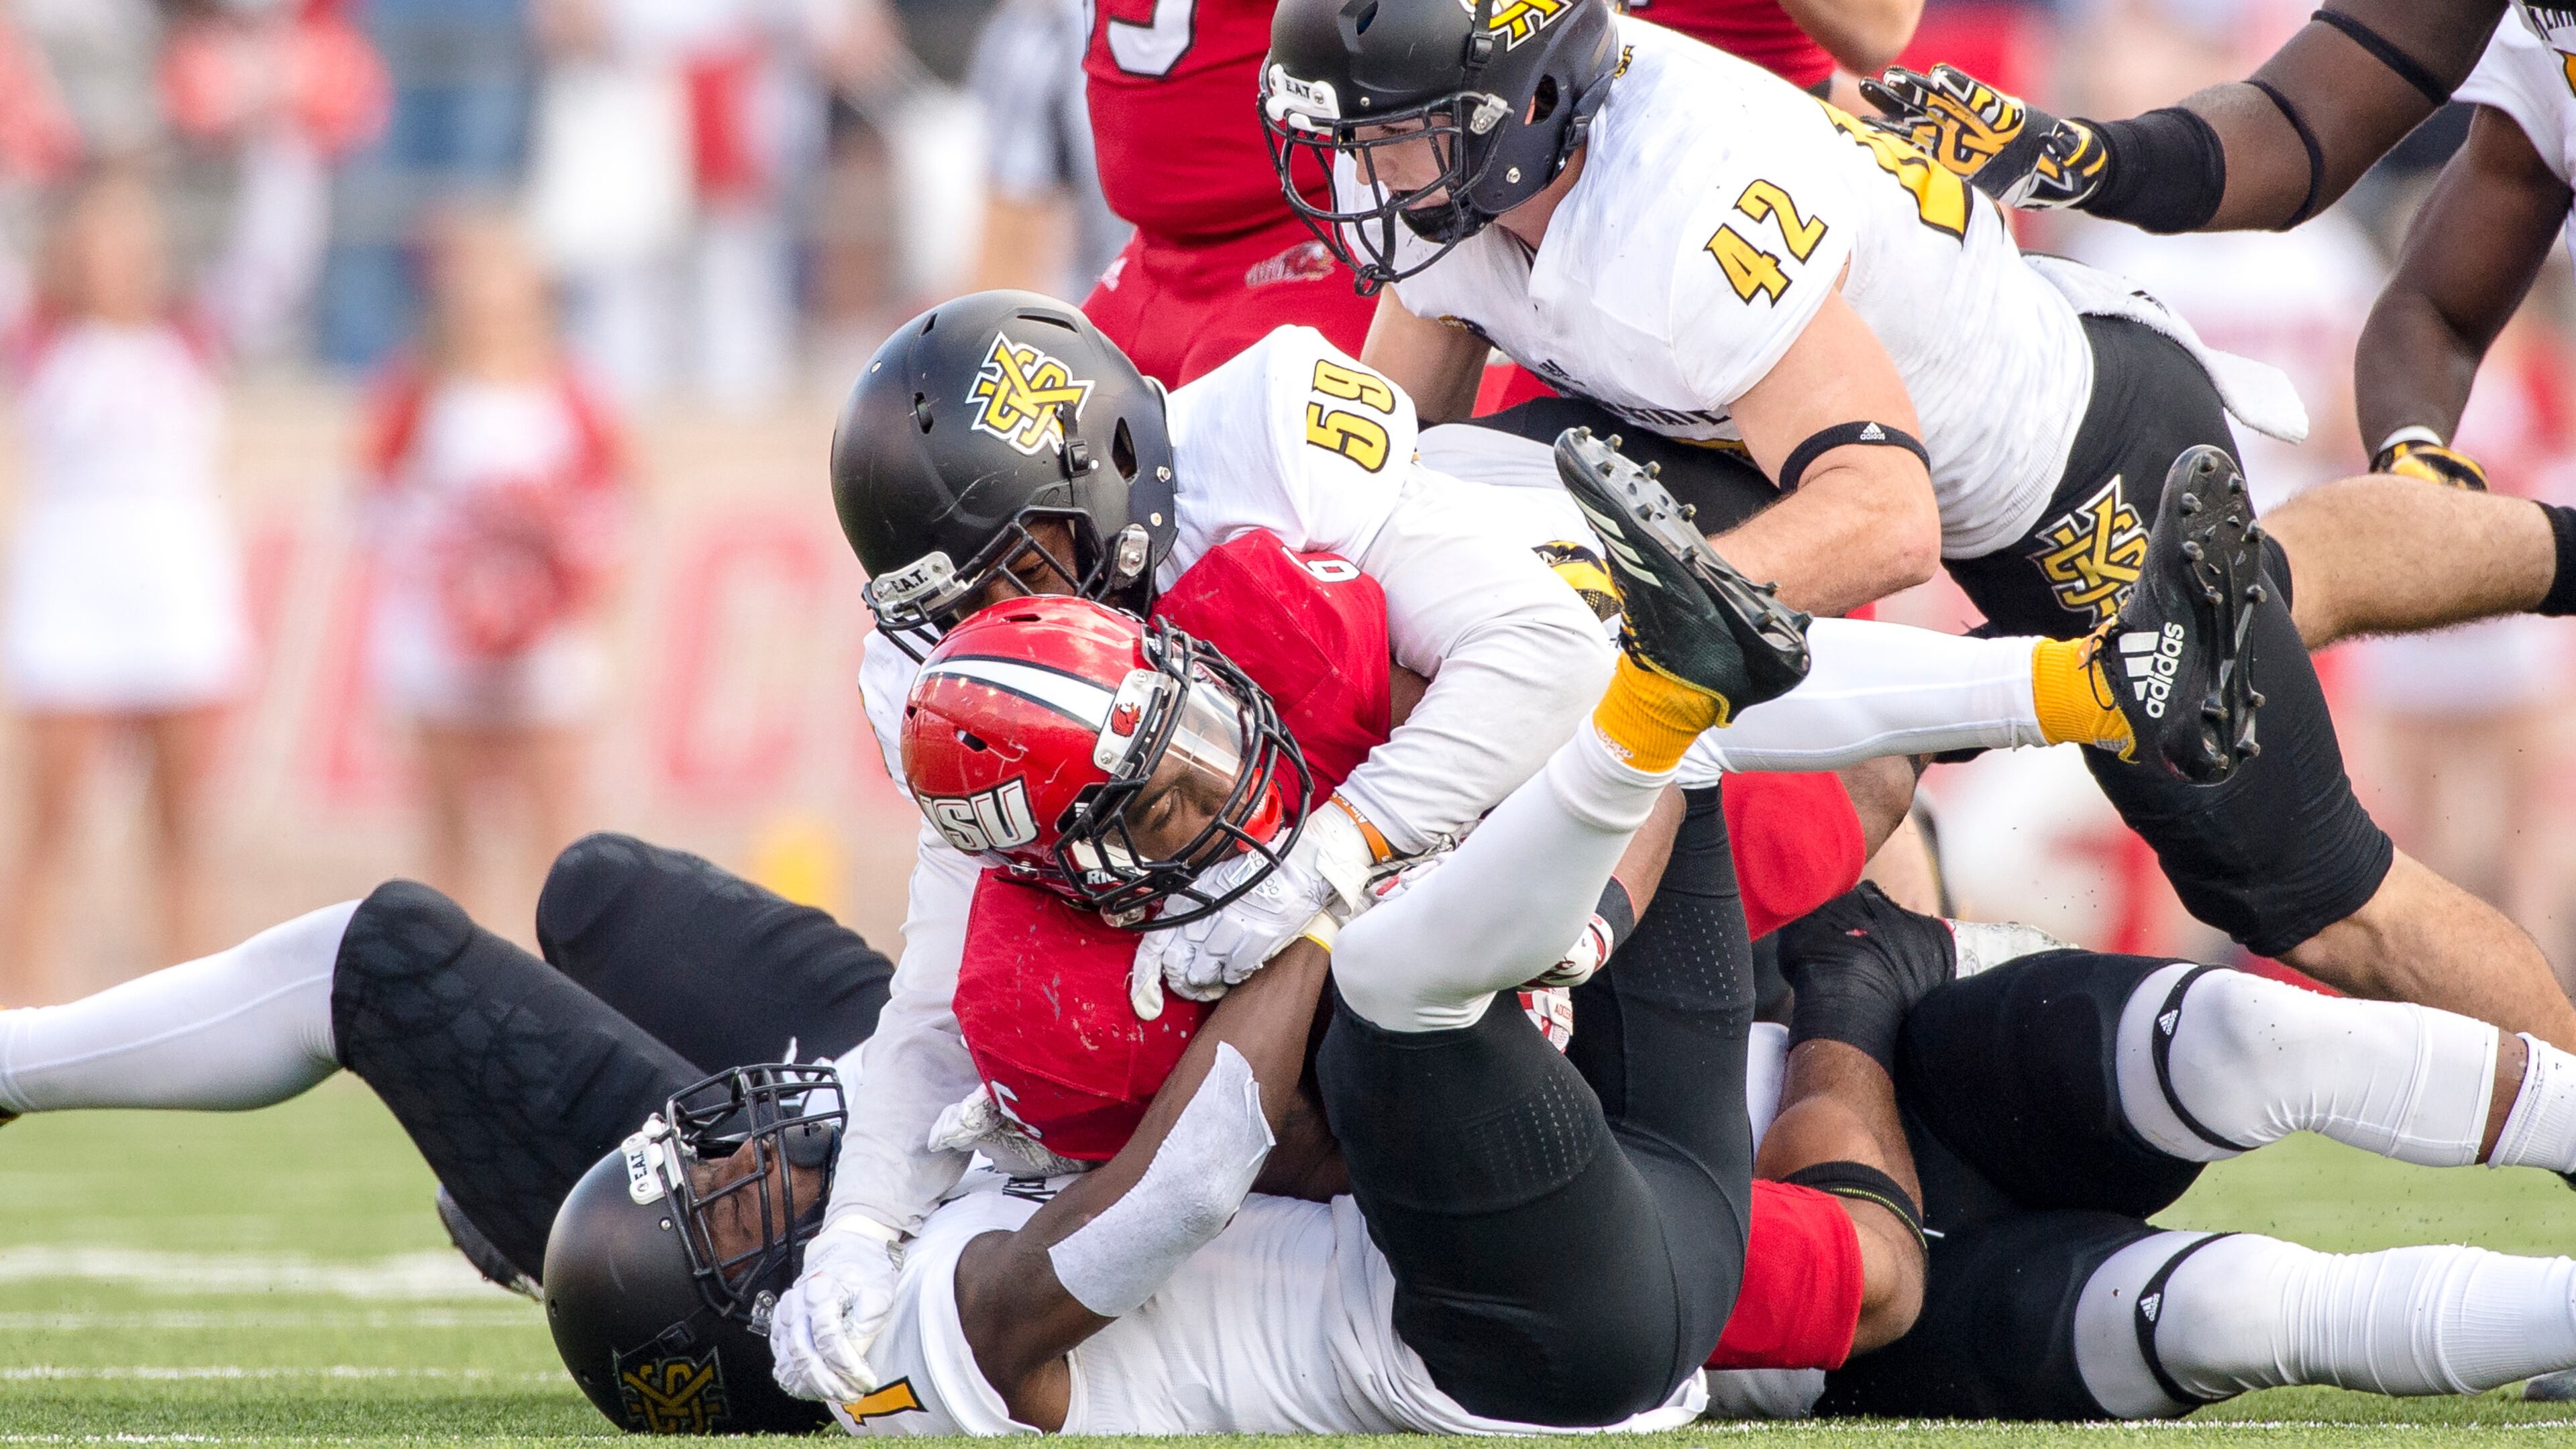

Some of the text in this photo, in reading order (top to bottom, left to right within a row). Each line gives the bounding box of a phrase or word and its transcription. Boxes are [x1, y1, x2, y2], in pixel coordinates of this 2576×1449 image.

[1703, 178, 1829, 309] 42
[1306, 358, 1395, 474] 59
[2147, 622, 2184, 718] adidas
